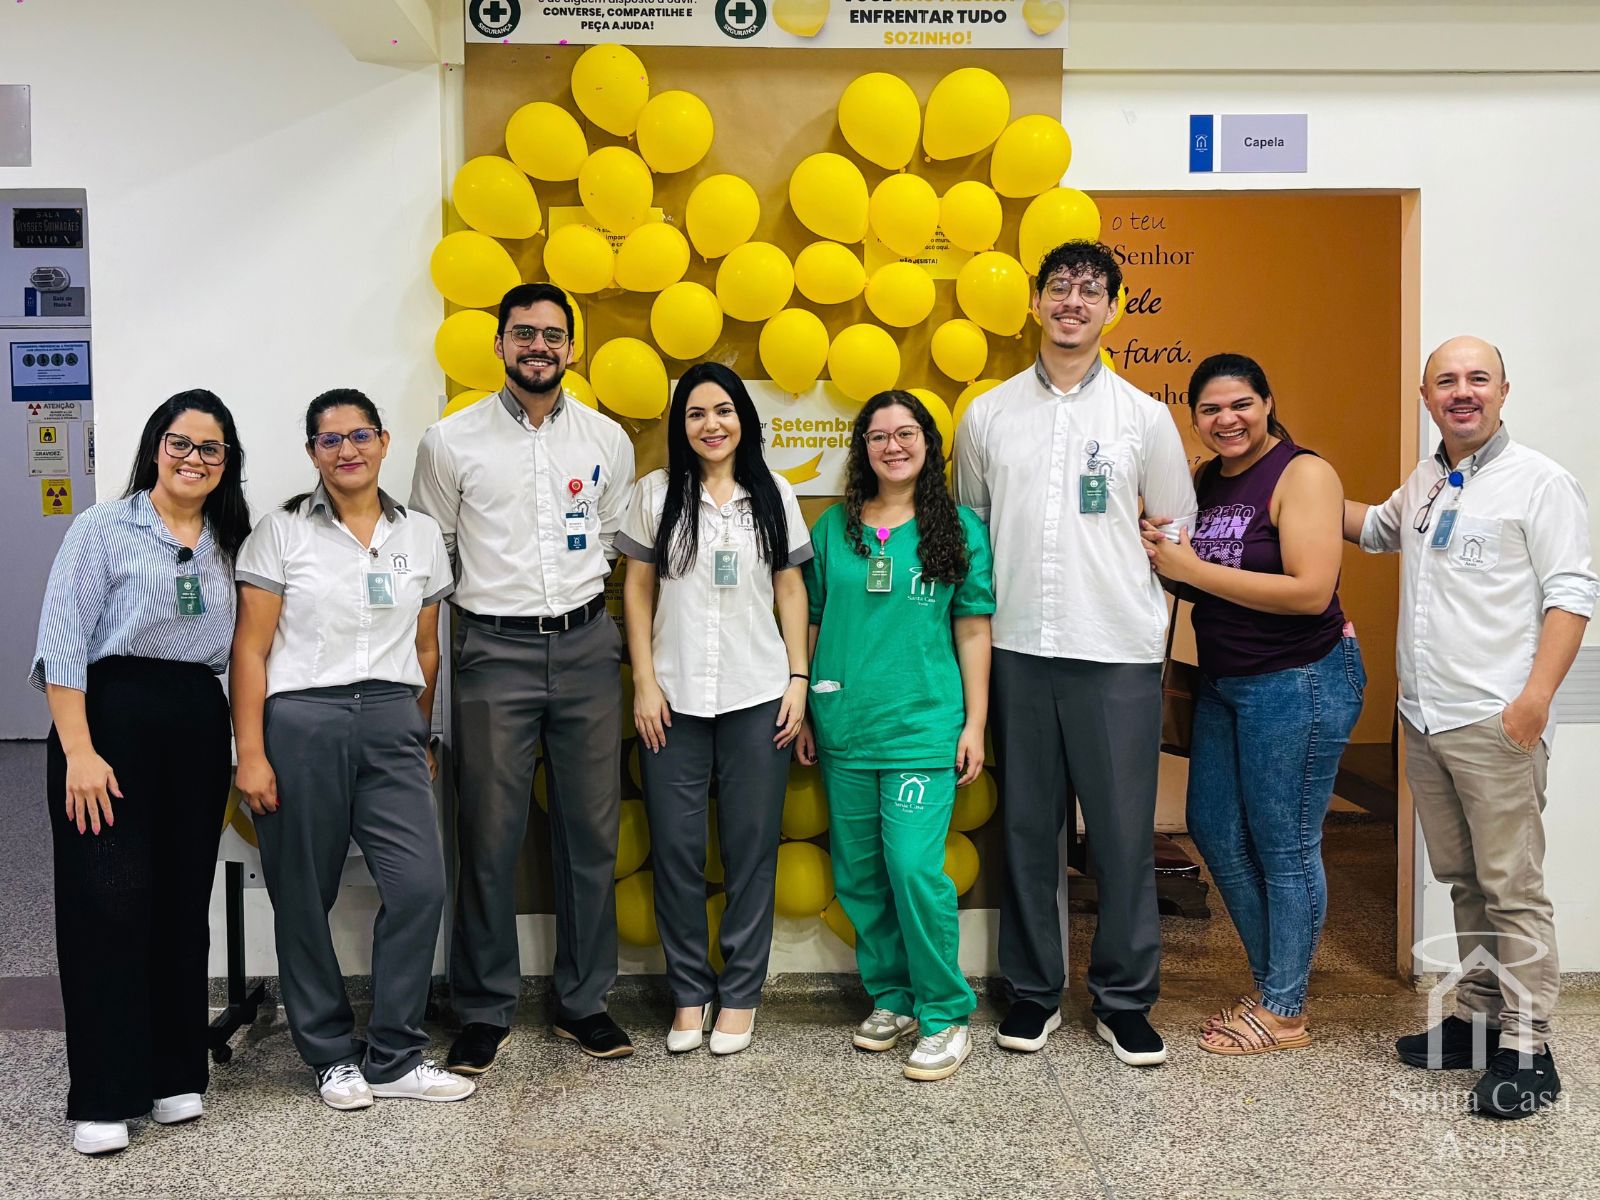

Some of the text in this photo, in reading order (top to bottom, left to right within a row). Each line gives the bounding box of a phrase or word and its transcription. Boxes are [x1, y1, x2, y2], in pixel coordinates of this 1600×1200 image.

[543, 7, 693, 17] CONVERSE, COMPARTILHE E
[850, 10, 1007, 24] ENFRENTAR TUDO
[581, 20, 654, 32] PEÇA AJUDA!
[884, 31, 972, 45] SOZINHO!
[1244, 137, 1285, 149] Capela
[1129, 212, 1167, 231] teu
[1113, 244, 1195, 266] Senhor
[1124, 287, 1162, 314] ele
[1124, 338, 1193, 369] fará.
[771, 417, 854, 432] Setembr
